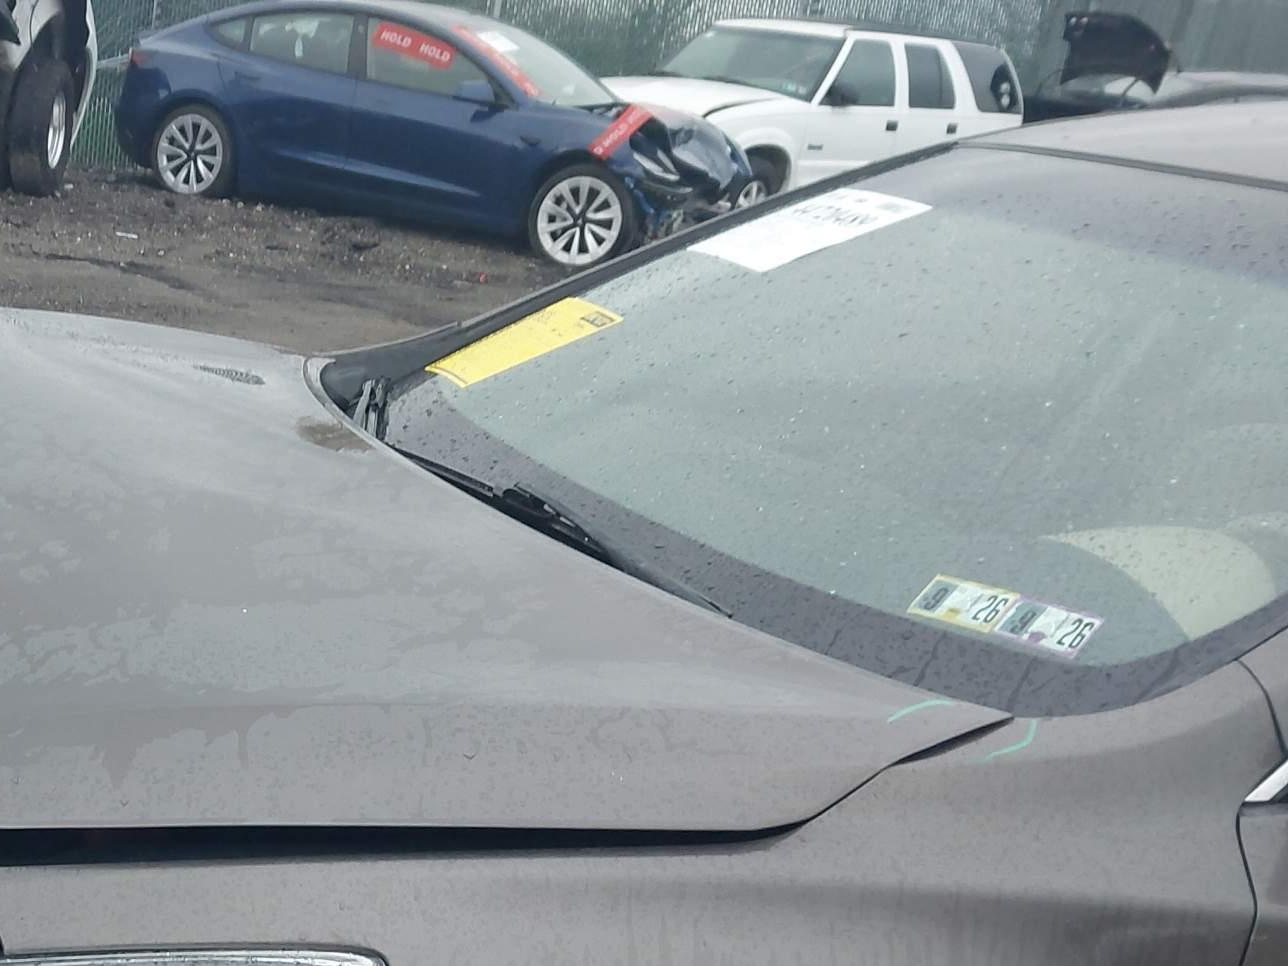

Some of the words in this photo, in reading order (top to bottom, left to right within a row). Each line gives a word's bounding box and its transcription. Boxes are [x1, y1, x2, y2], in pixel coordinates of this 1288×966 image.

[380, 30, 412, 48] HOLD
[419, 43, 450, 62] HOLD
[972, 595, 1009, 623] 26
[1056, 618, 1097, 649] 26
